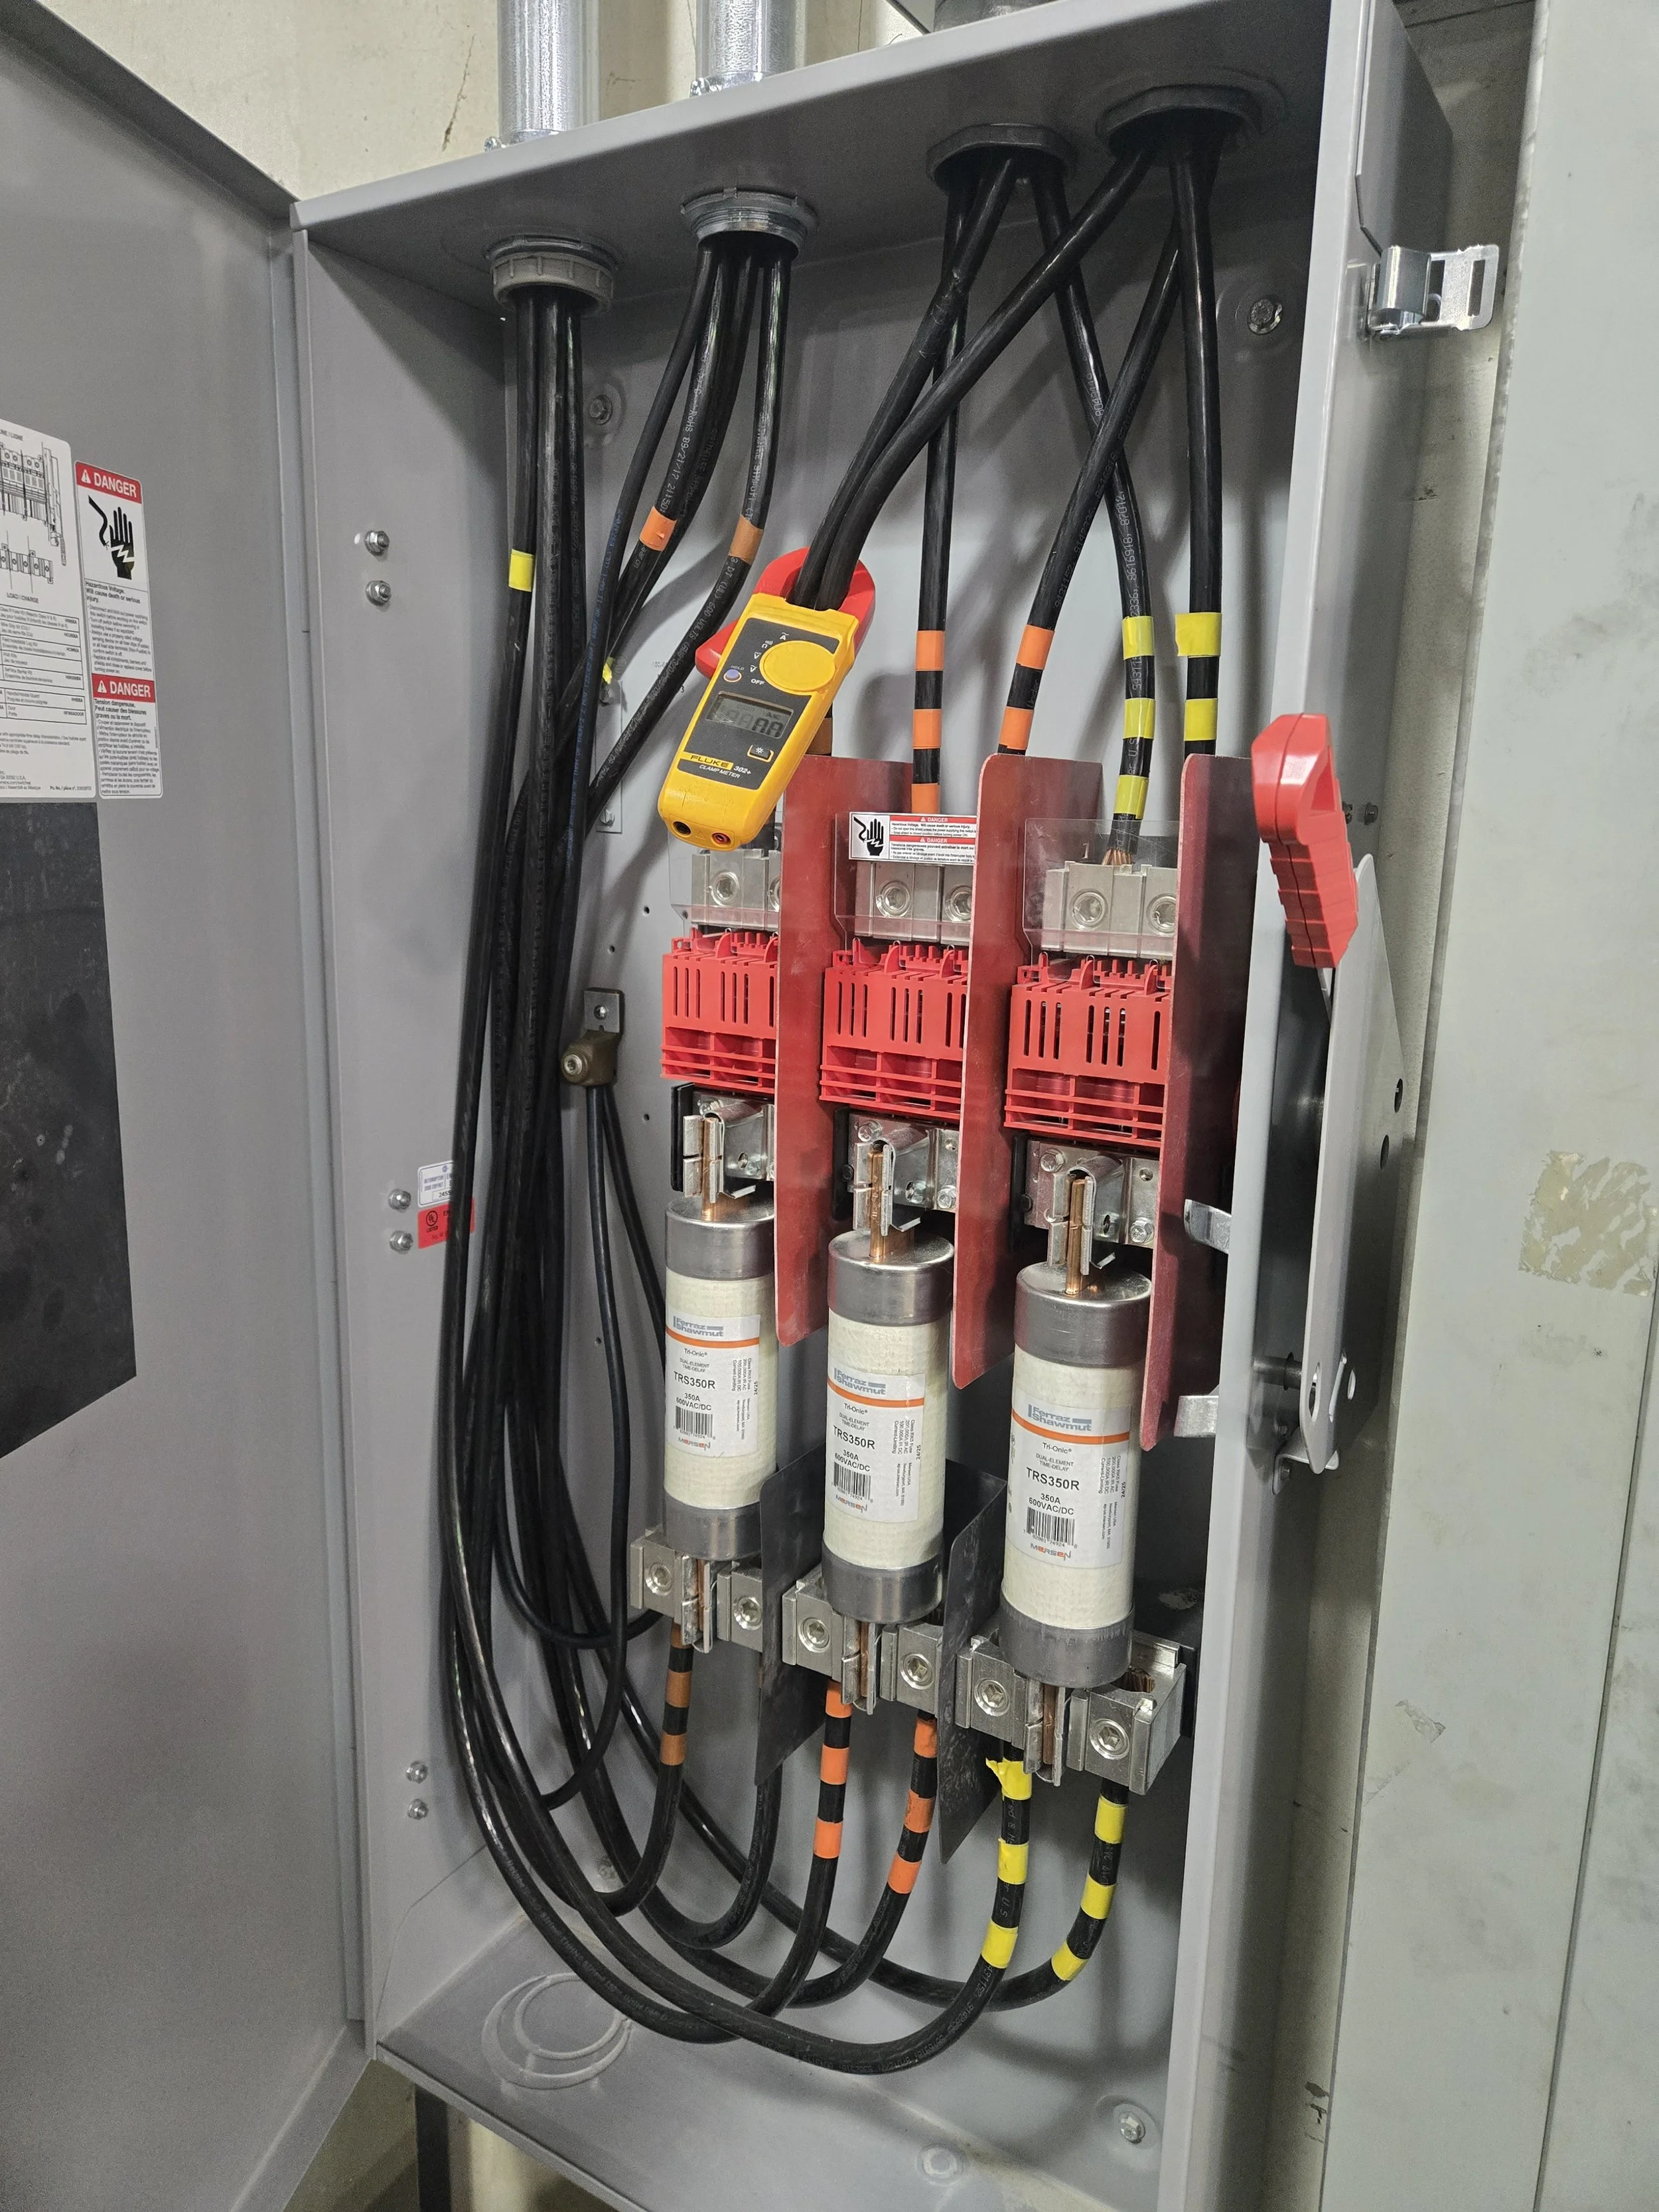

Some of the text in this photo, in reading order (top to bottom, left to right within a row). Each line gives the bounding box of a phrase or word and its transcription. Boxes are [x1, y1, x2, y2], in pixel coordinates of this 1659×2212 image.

[94, 472, 137, 498] DANGER
[689, 619, 707, 640] VOLTS
[109, 681, 151, 698] DANGER
[690, 755, 752, 775] FLUKE 302+
[699, 764, 741, 778] CLAMP METER
[676, 1323, 723, 1337] Shawmut
[677, 1317, 705, 1330] Ferraz
[680, 1358, 709, 1368] DUAL-ELEMENT
[682, 1364, 705, 1372] TIME-DELAY
[674, 1370, 715, 1389] TRS350R
[837, 1369, 867, 1386] Ferraz
[837, 1375, 885, 1394] Shawmut
[676, 1397, 711, 1410] 600VAC/DC
[684, 1392, 700, 1402] 350A
[839, 1412, 869, 1426] DUAL-ELEMENT
[1033, 1406, 1070, 1422] Ferraz
[841, 1419, 865, 1431] TIME-DELAY
[1033, 1413, 1092, 1431] Shawmut
[833, 1425, 875, 1449] TRS350R
[835, 1453, 871, 1471] 600VAC/DC
[843, 1449, 859, 1461] 350A
[1035, 1453, 1074, 1467] DUAL-ELEMENT
[1039, 1460, 1069, 1471] TIME-DELAY
[1026, 1467, 1079, 1491] TRS350R
[1029, 1497, 1074, 1514] 600VAC/DC
[1041, 1493, 1060, 1505] 350A
